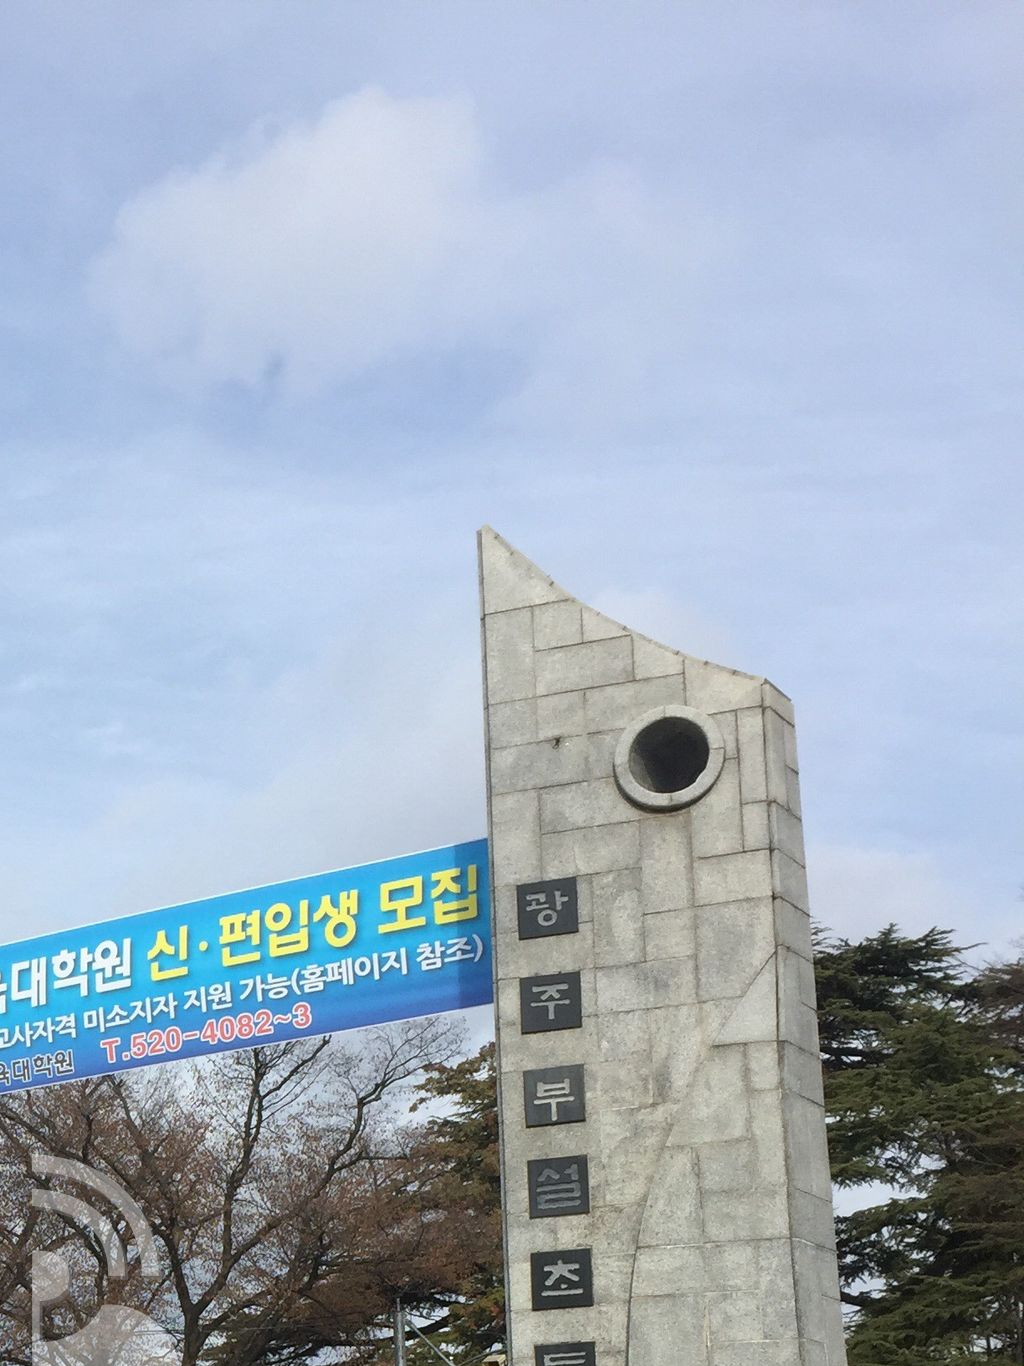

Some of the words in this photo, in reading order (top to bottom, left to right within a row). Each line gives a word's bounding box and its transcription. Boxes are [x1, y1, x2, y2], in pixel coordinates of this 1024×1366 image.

[378, 864, 478, 934] 모집
[83, 992, 178, 1033] 미소지자
[183, 981, 233, 1013] 지원
[416, 934, 483, 971] 참조)
[101, 1001, 312, 1063] T.520-4082~3
